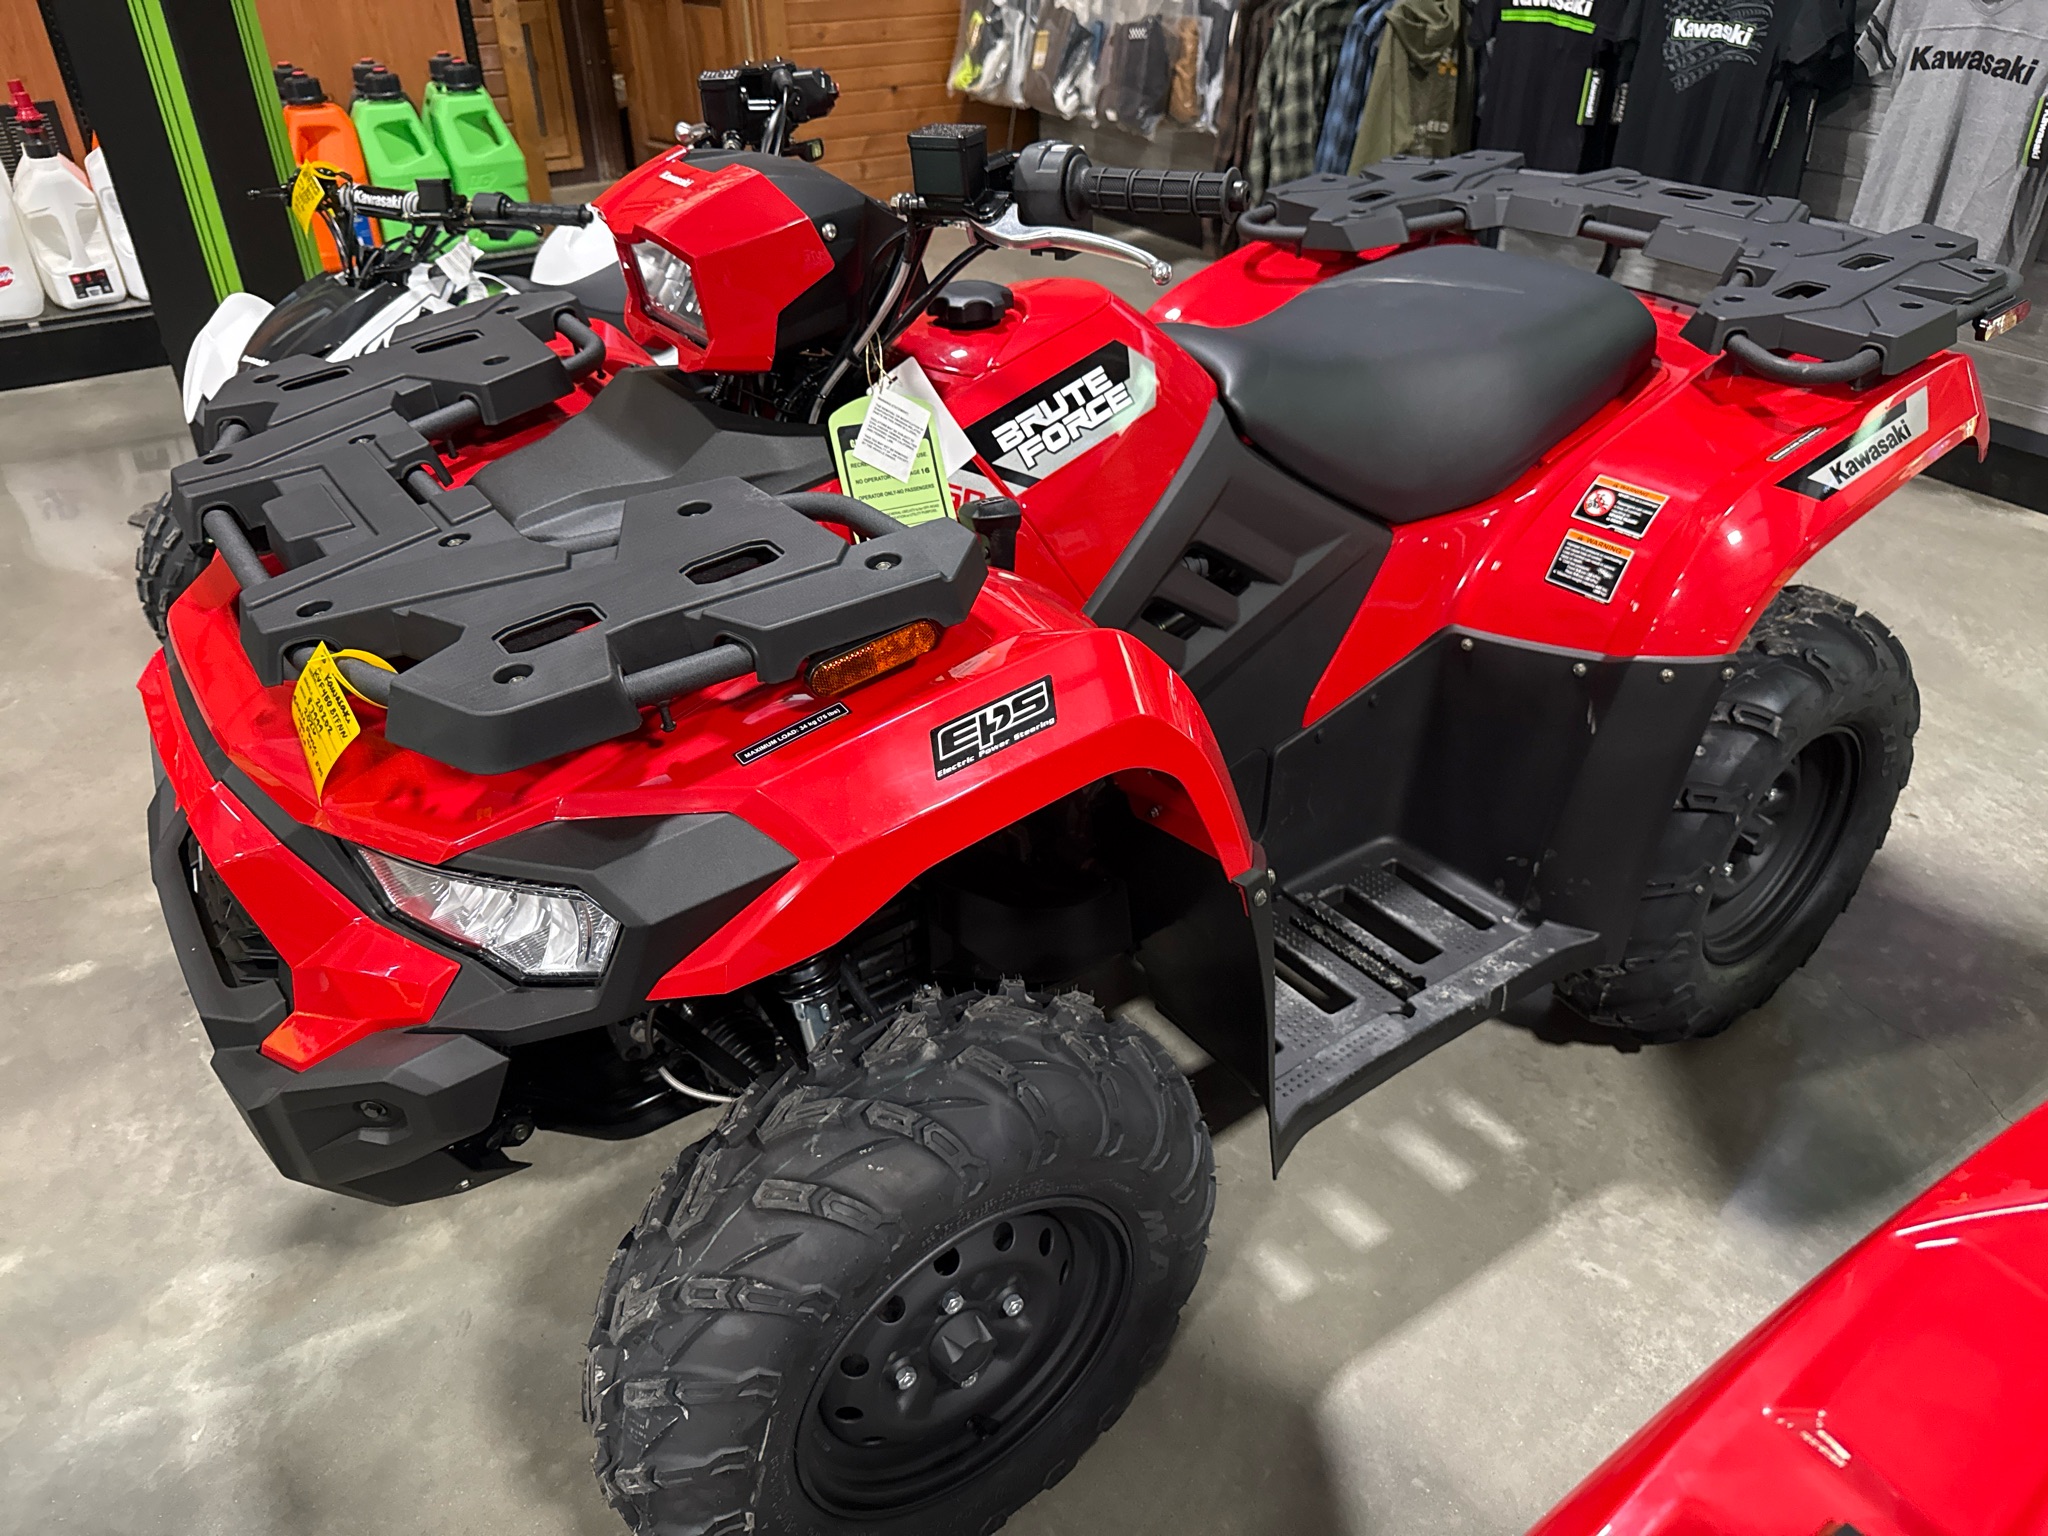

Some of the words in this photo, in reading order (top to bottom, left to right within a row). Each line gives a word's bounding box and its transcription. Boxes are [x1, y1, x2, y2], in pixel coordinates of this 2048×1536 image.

[1909, 45, 2039, 85] Kawasaki
[353, 189, 403, 209] Kawasaki
[991, 365, 1113, 453] BRUTE
[1017, 382, 1134, 470] FORCE
[1828, 418, 1912, 485] Kawasaki
[904, 482, 934, 493] PASSENGERS
[1586, 537, 1622, 555] WARNING
[744, 739, 777, 758] MAXIMUM
[777, 728, 799, 742] LOAD:
[799, 723, 808, 731] 34
[807, 719, 818, 727] kg
[816, 713, 827, 723] (75
[827, 708, 841, 717] lbs)
[936, 755, 975, 778] Electric
[978, 738, 1010, 758] Power
[1013, 717, 1055, 741] Steering
[937, 680, 1049, 761] EPS
